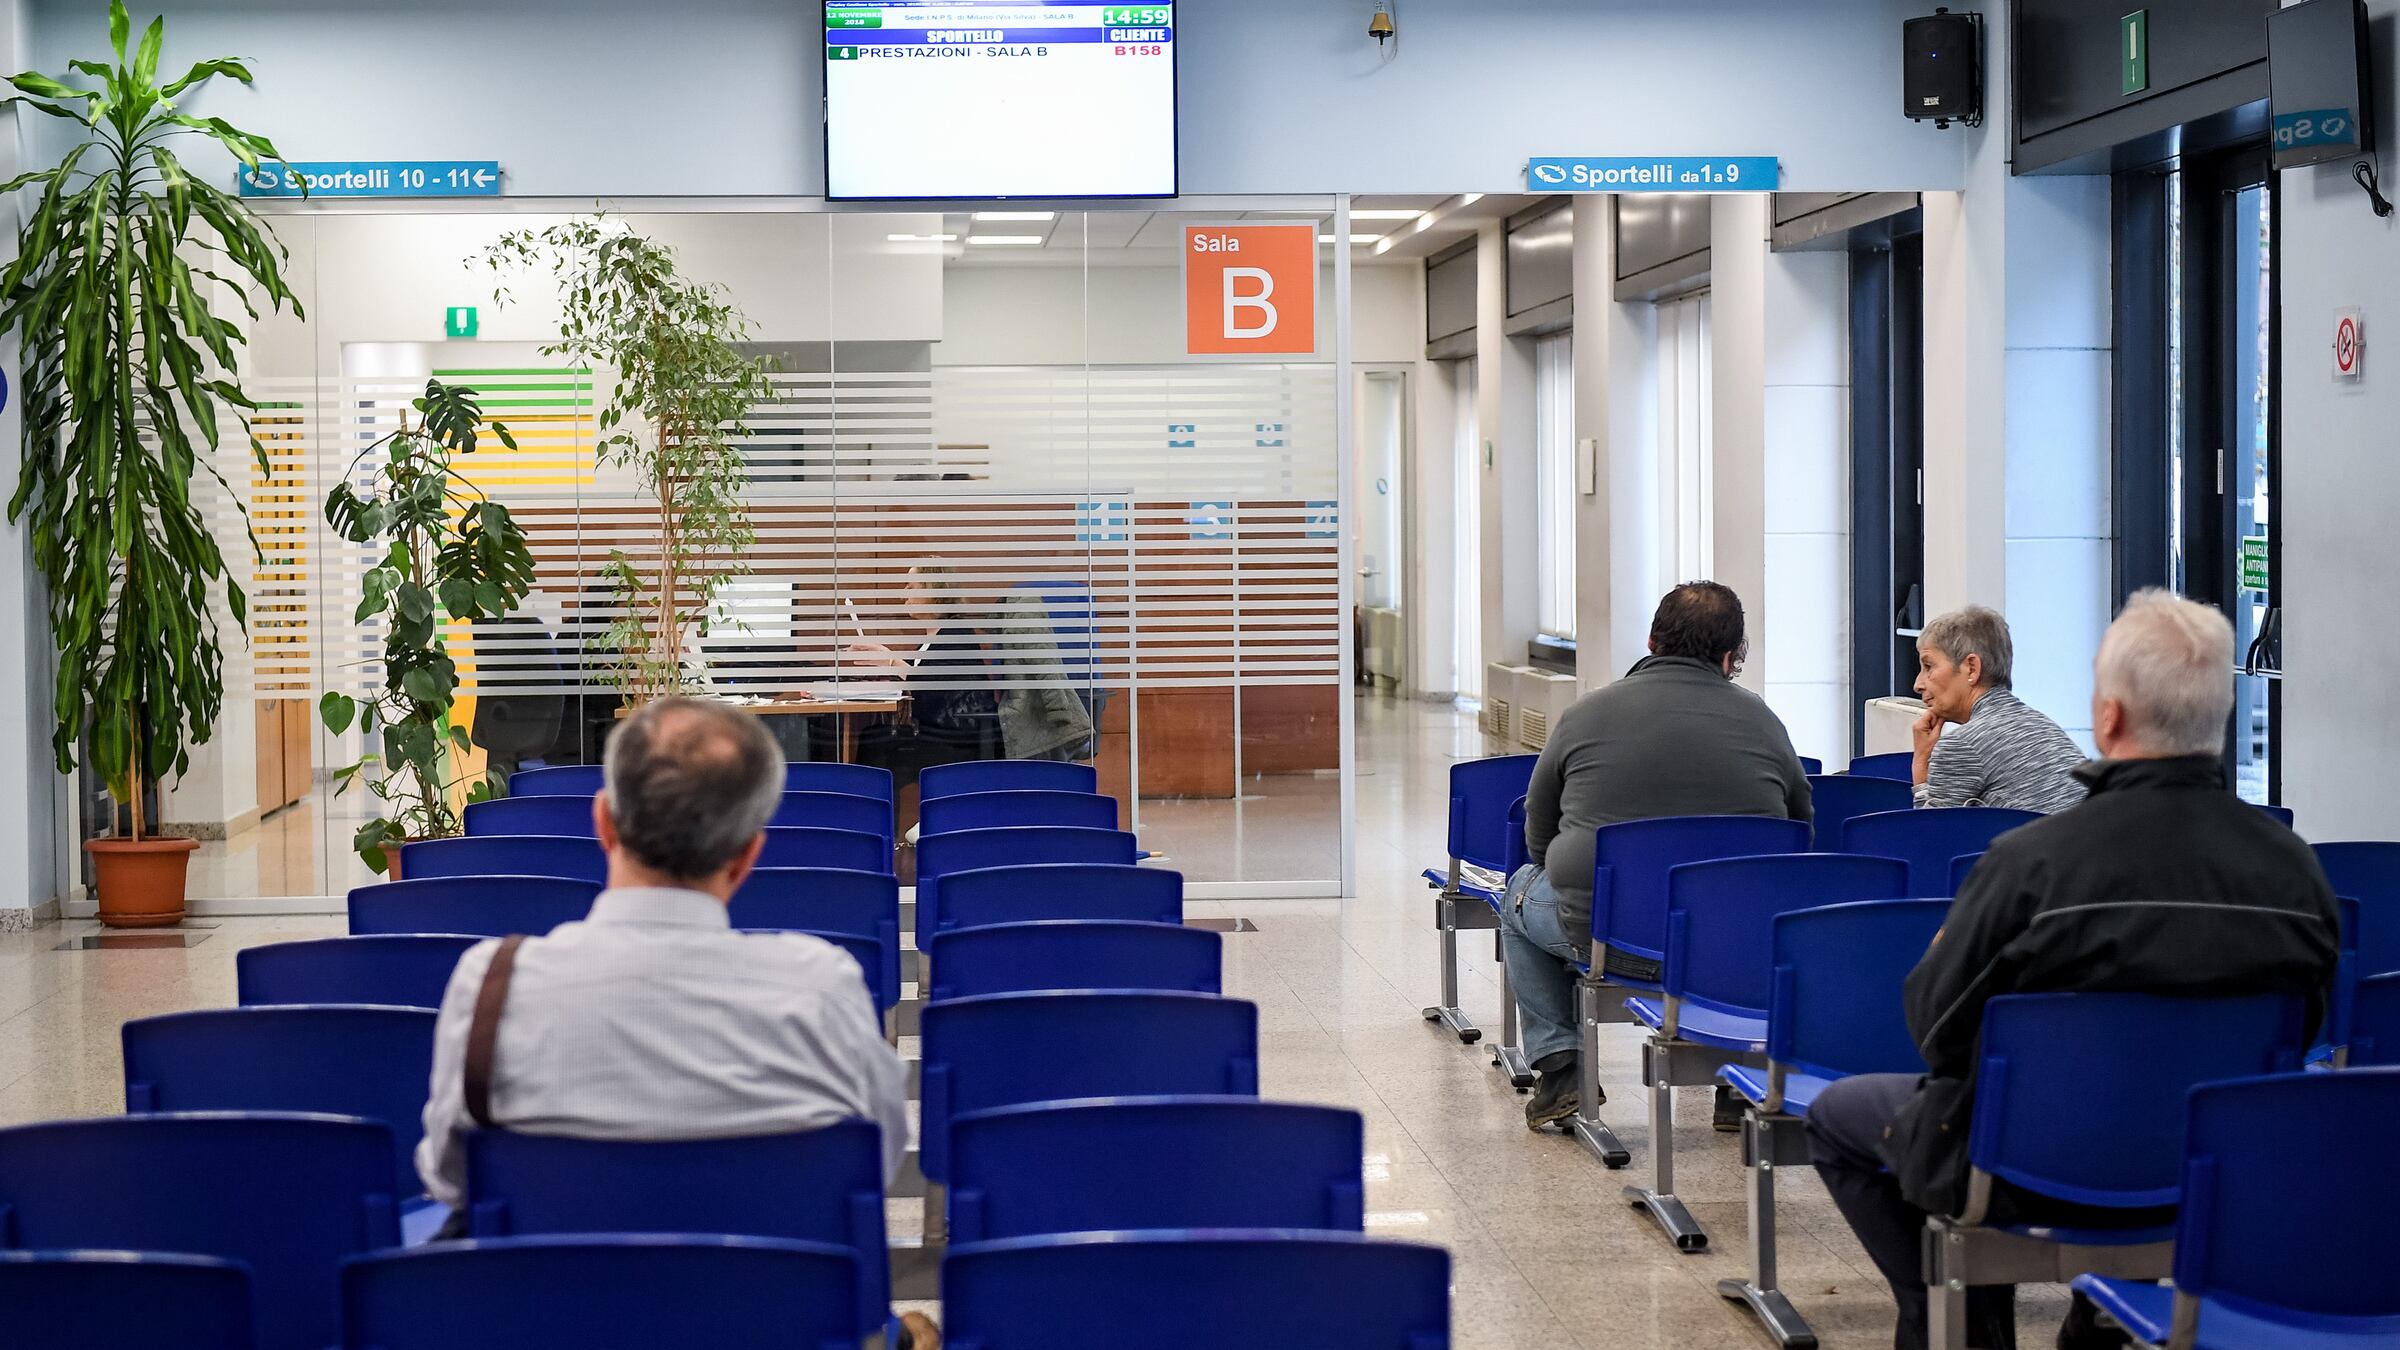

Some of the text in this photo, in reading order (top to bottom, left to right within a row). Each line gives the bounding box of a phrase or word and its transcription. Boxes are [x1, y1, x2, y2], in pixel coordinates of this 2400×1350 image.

[1104, 10, 1168, 24] 14:59
[926, 30, 1004, 43] SPORTELLO
[1110, 29, 1165, 42] CLIENTE
[839, 47, 850, 59] 4
[859, 47, 971, 58] PRESTAZIONI
[987, 47, 1032, 57] SALA
[1037, 47, 1048, 57] B
[1115, 45, 1161, 56] B158
[284, 168, 389, 190] Sportelli
[399, 168, 425, 188] 10
[447, 168, 469, 188] 11
[1572, 164, 1672, 187] Sportelli
[1726, 164, 1739, 183] 9
[1193, 233, 1240, 252] Sala
[1223, 267, 1278, 339] B
